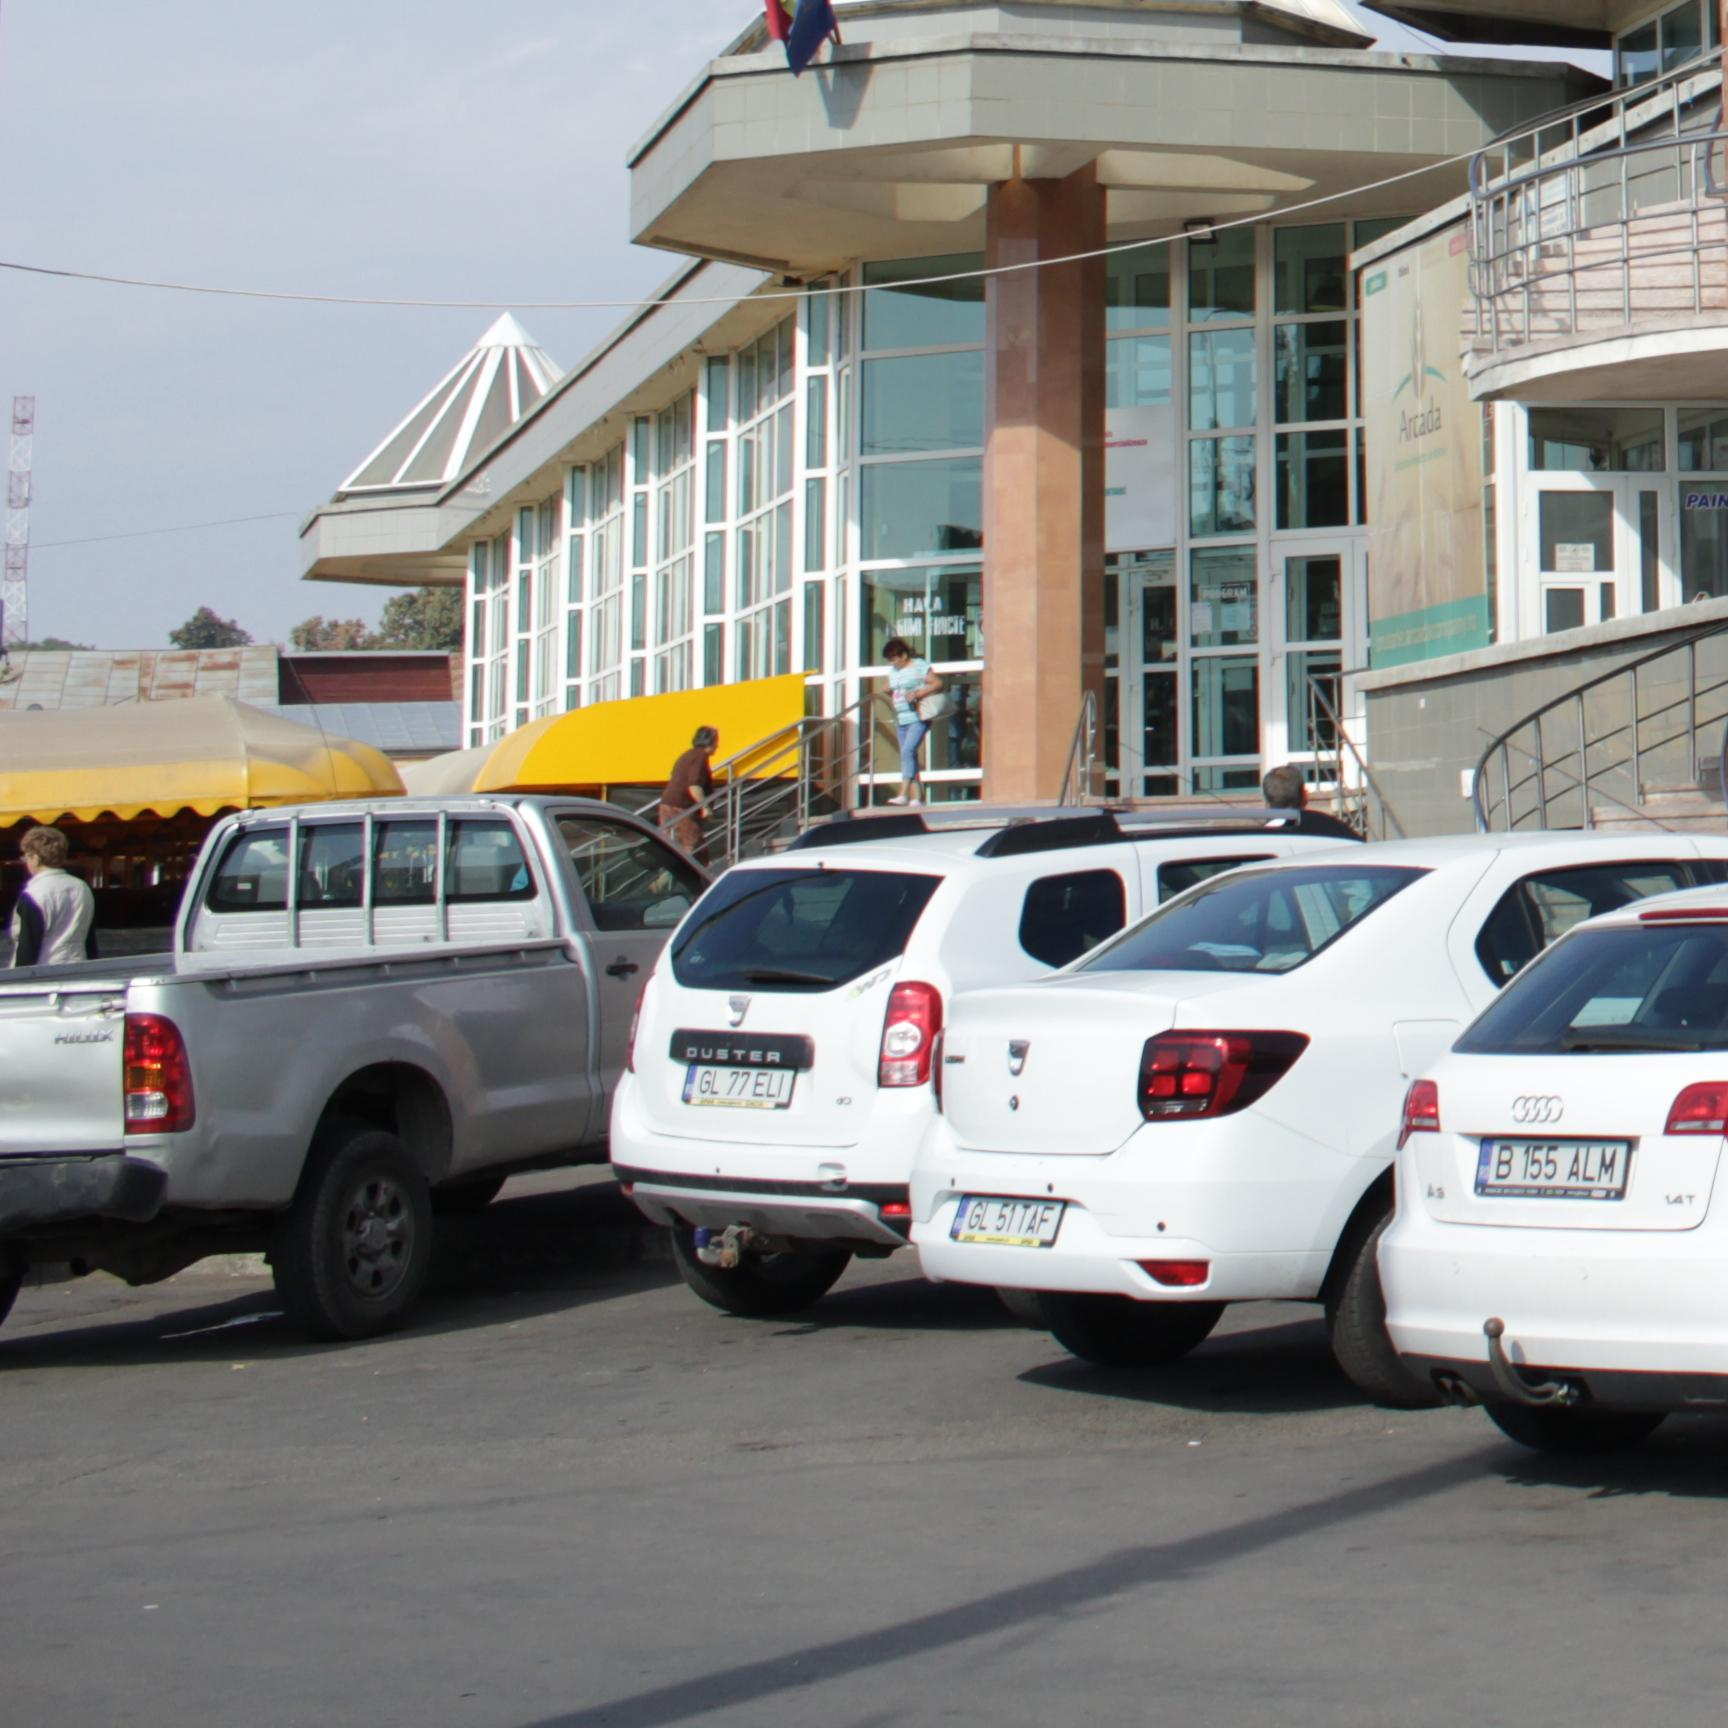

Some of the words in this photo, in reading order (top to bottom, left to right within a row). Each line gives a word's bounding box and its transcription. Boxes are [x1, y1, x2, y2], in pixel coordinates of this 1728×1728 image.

[1400, 395, 1442, 444] Arcada
[686, 1047, 781, 1063] DUSTER
[700, 1070, 719, 1095] GL
[727, 1071, 752, 1096] 77
[752, 1072, 785, 1098] ELI
[1495, 1145, 1514, 1179] B
[1523, 1145, 1558, 1180] 155
[1567, 1146, 1618, 1183] ALM
[968, 1201, 989, 1230] GL
[996, 1203, 1017, 1232] 51
[1018, 1204, 1056, 1234] TAF
